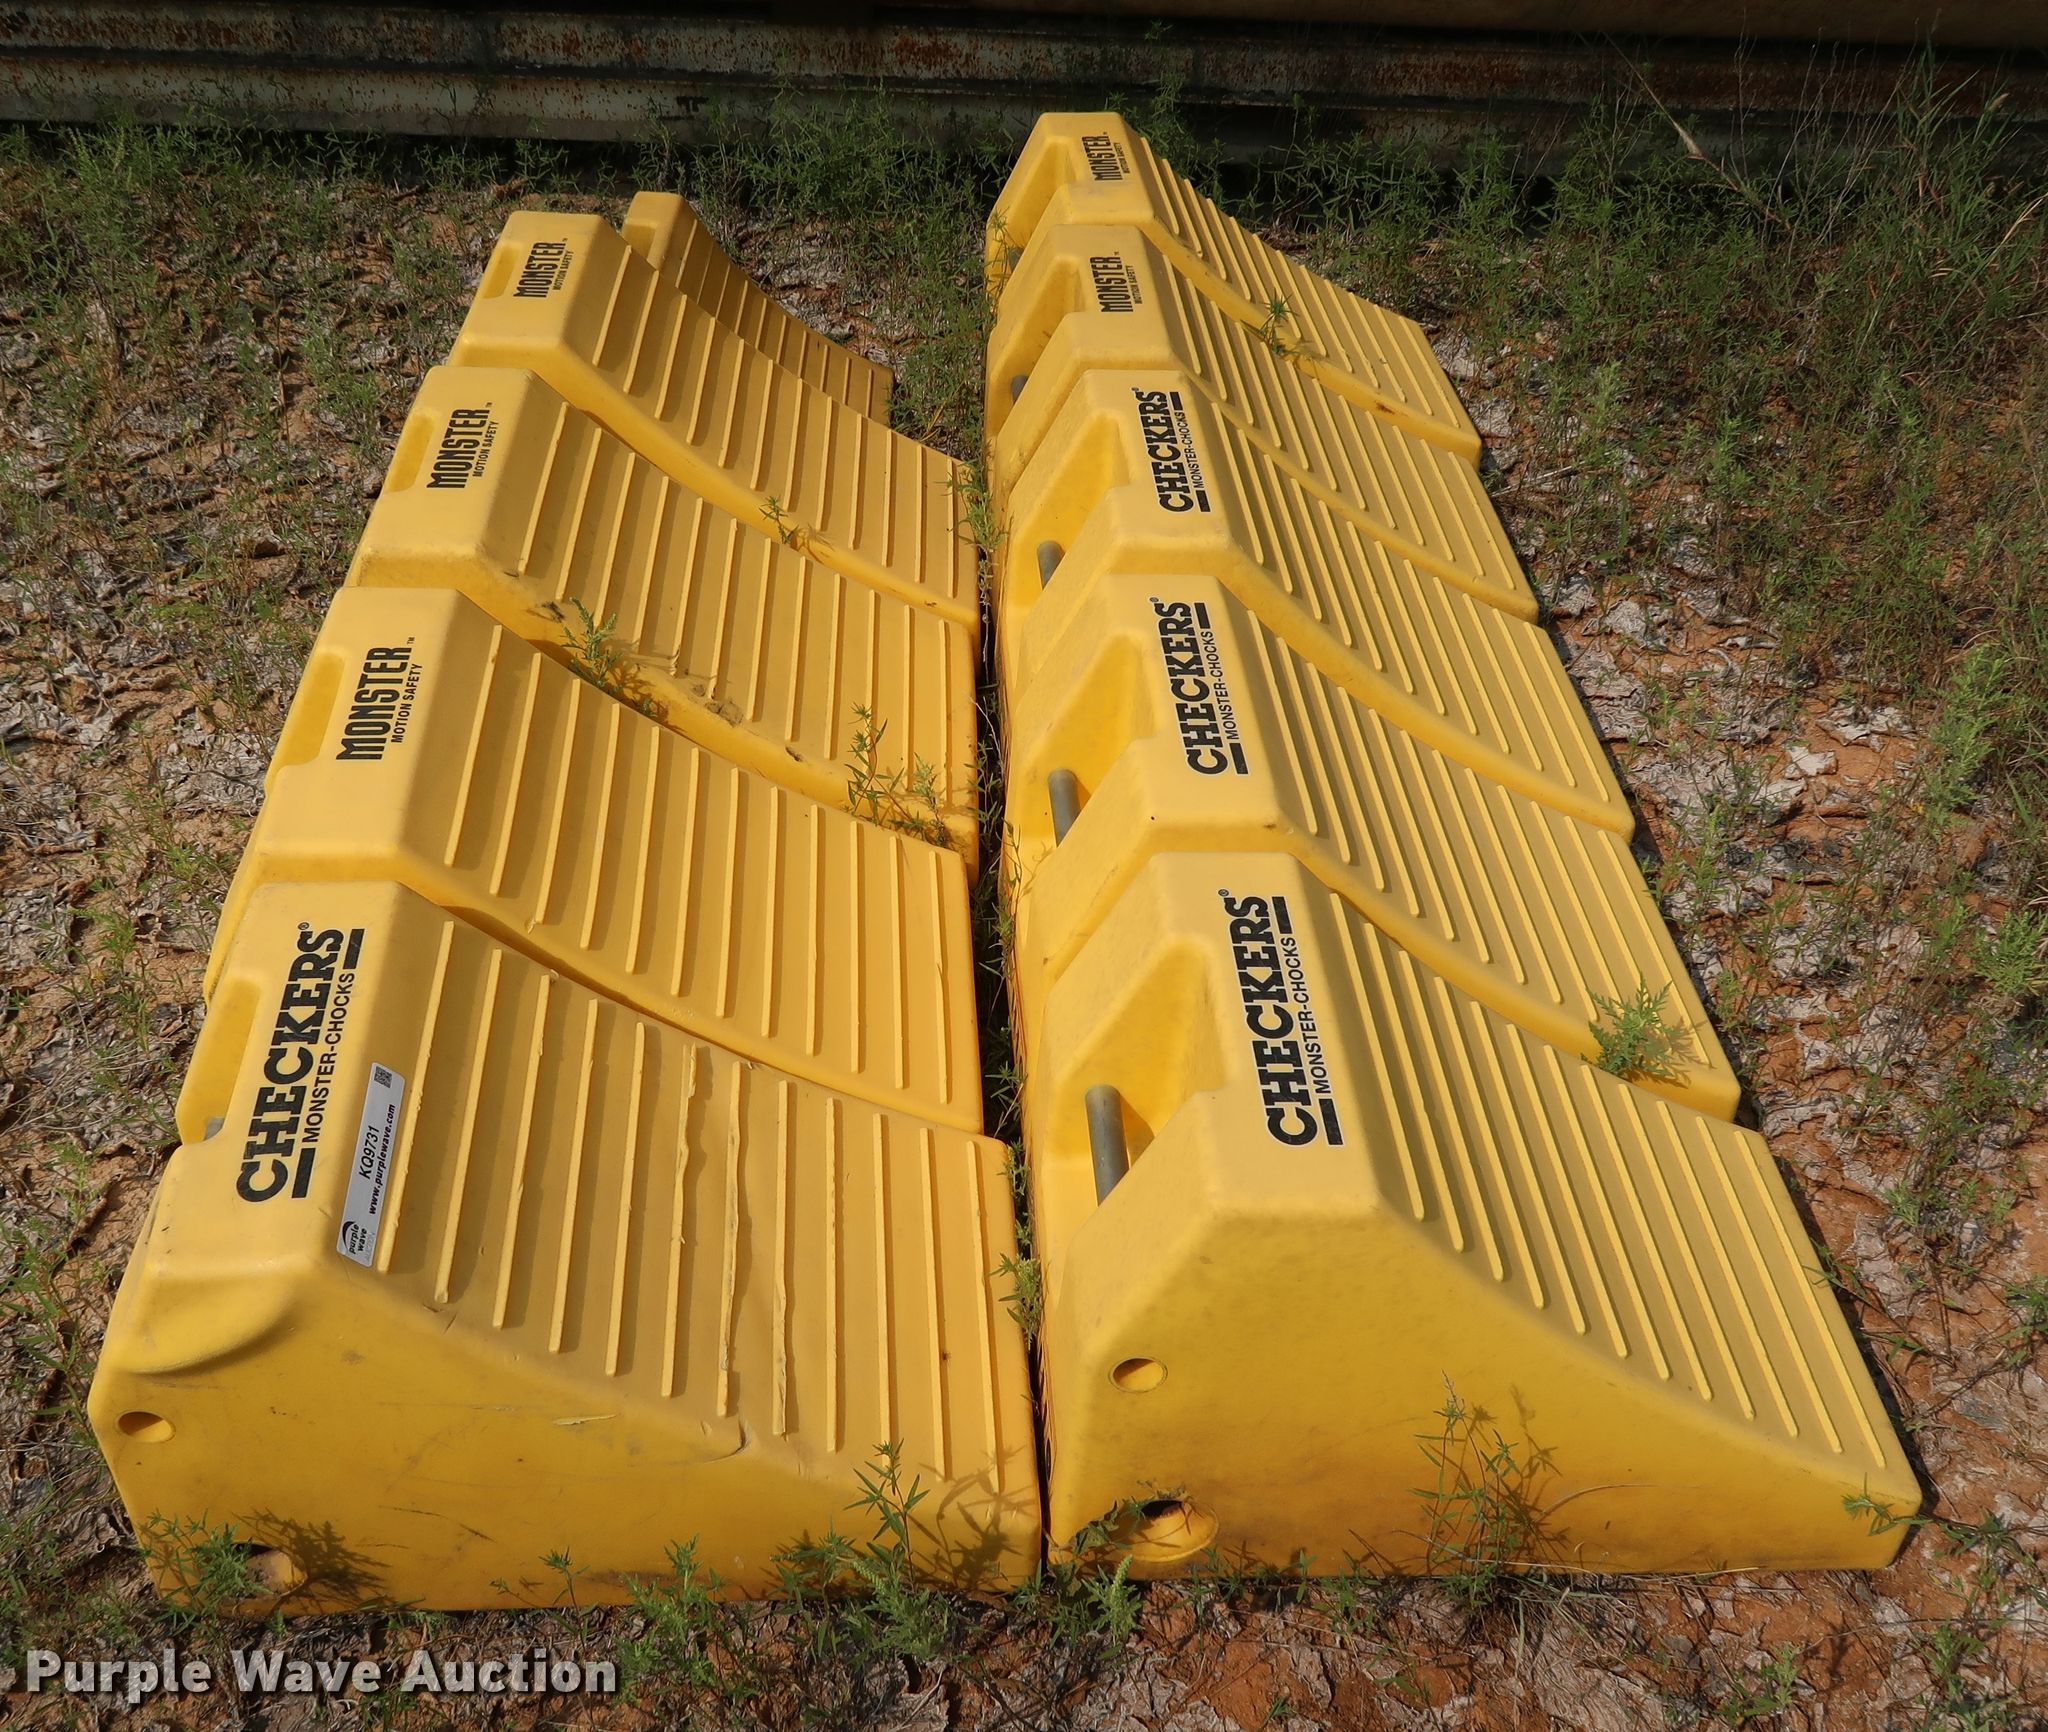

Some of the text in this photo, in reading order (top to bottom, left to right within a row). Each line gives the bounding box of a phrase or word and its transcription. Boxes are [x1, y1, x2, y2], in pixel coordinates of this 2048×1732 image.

[472, 420, 500, 477] MOTION SAFETY
[1173, 411, 1205, 489] MONSTER-CHOCKS
[390, 662, 424, 744] MOTION SAFETY
[1200, 630, 1240, 740] MONSTER-CHOCKS
[1280, 936, 1332, 1094] MONSTER-CHOCKS
[302, 972, 356, 1144] MONSTER-CHOCKS
[358, 1125, 381, 1180] KQ9731
[368, 1103, 396, 1216] www.purplewave.com
[348, 1224, 360, 1255] purple
[357, 1228, 368, 1252] wave
